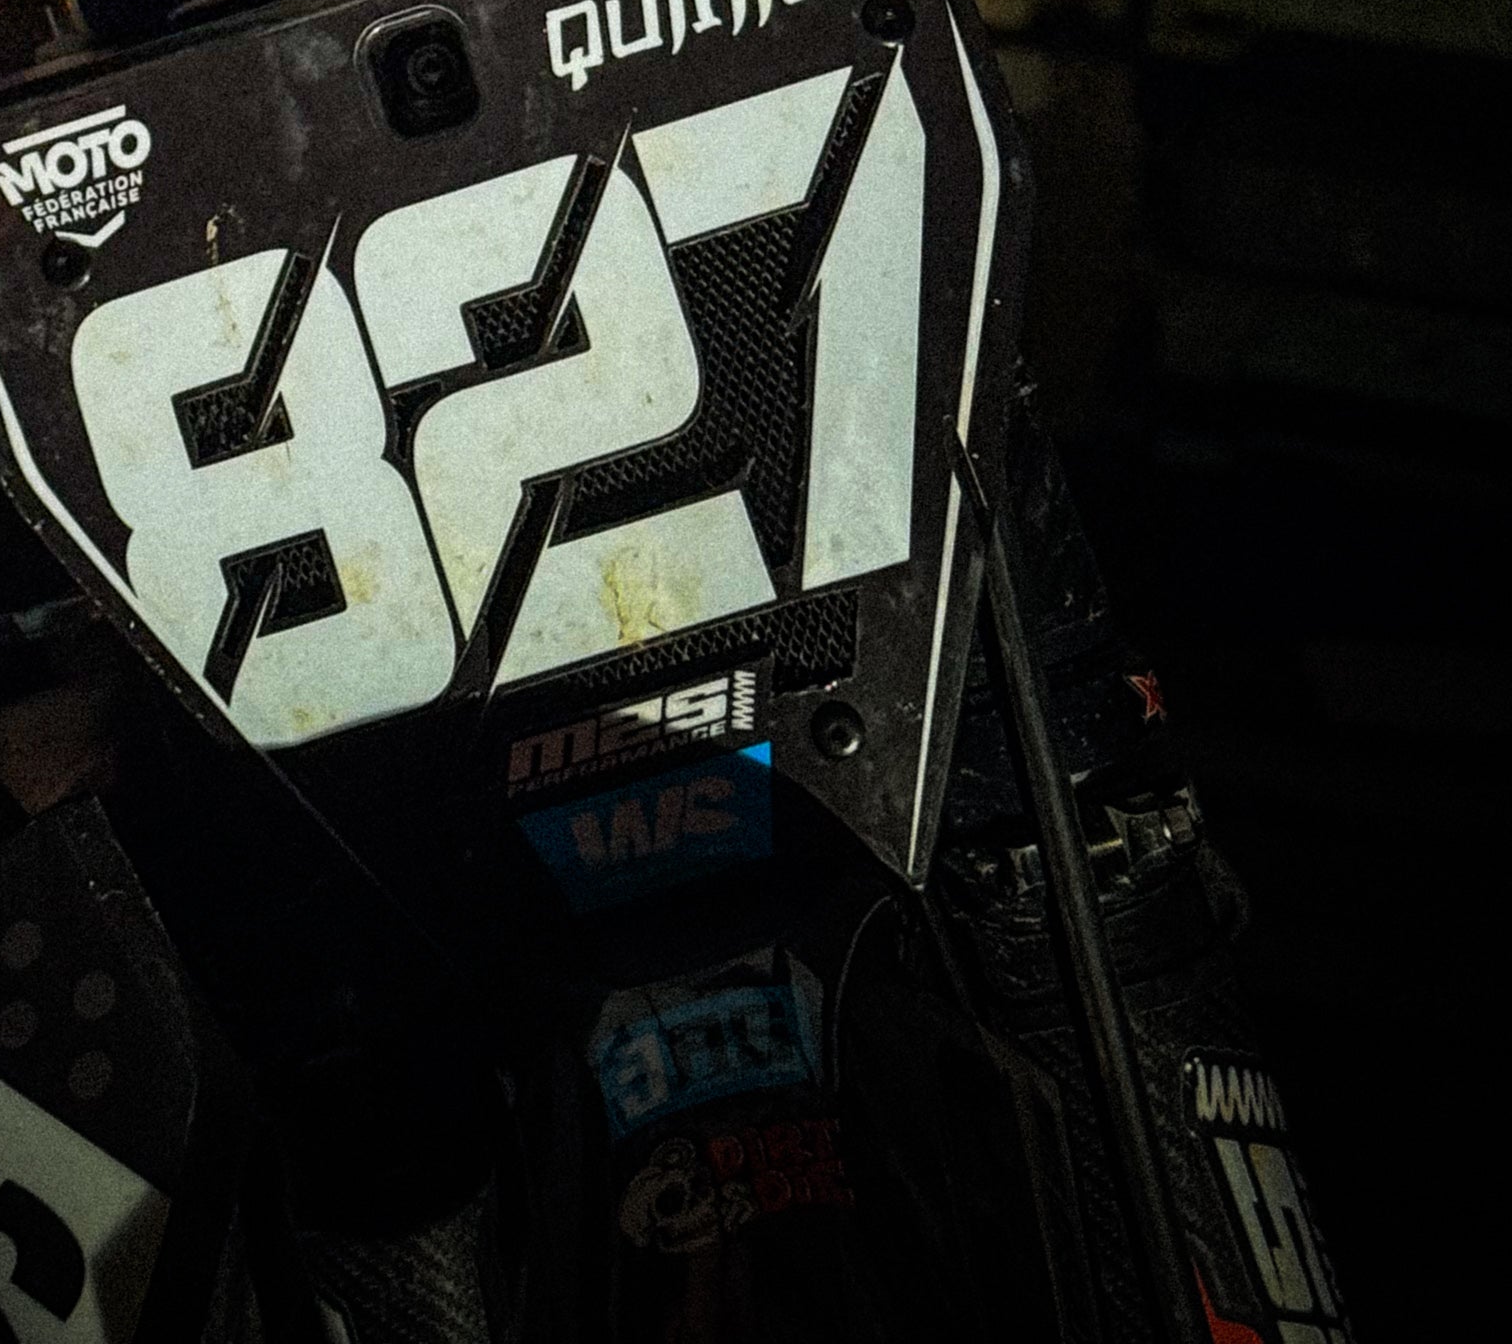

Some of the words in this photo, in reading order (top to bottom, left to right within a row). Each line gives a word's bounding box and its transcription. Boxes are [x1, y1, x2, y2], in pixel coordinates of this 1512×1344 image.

[21, 169, 144, 223] FÉDÉRATION
[32, 187, 141, 235] FRANÇAISE
[71, 44, 928, 750] 827
